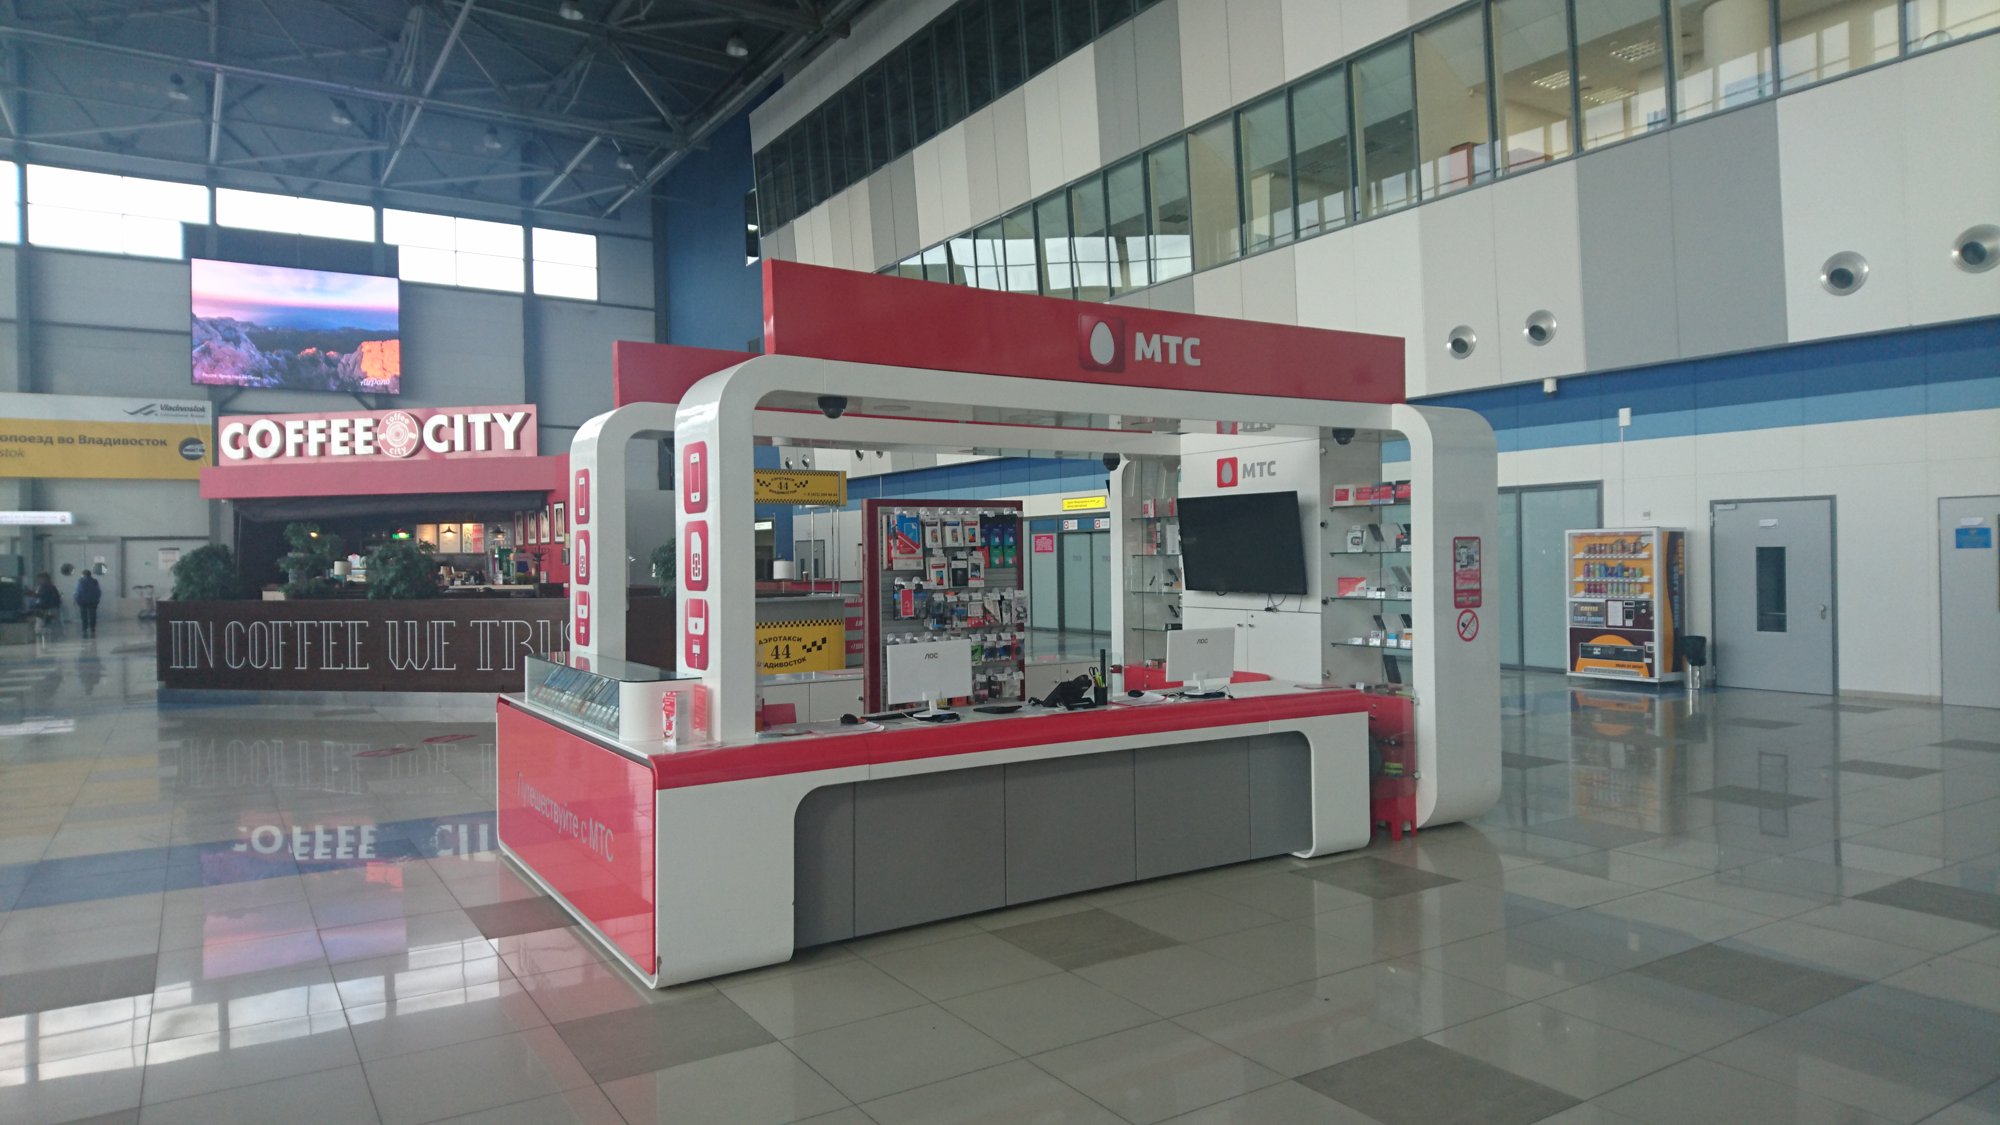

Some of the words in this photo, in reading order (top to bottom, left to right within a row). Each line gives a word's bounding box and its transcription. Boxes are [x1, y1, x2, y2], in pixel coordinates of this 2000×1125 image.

[1135, 332, 1201, 366] МТС
[160, 403, 206, 414] Vladivostok
[385, 412, 410, 425] coffee
[78, 434, 168, 447] Владивосток
[221, 418, 375, 460] COFFEE
[423, 411, 526, 453] CITY
[389, 446, 407, 455] city
[1242, 460, 1277, 479] МТС
[169, 620, 214, 669] IN
[224, 620, 369, 669] COFFEE
[385, 620, 456, 671] WE
[470, 619, 570, 670] TRU
[758, 636, 802, 645] АЭРОТАКСИ
[770, 644, 792, 660] 44
[756, 656, 807, 669] АДИВОСТОК
[580, 820, 588, 844] с
[589, 816, 614, 863] МТС
